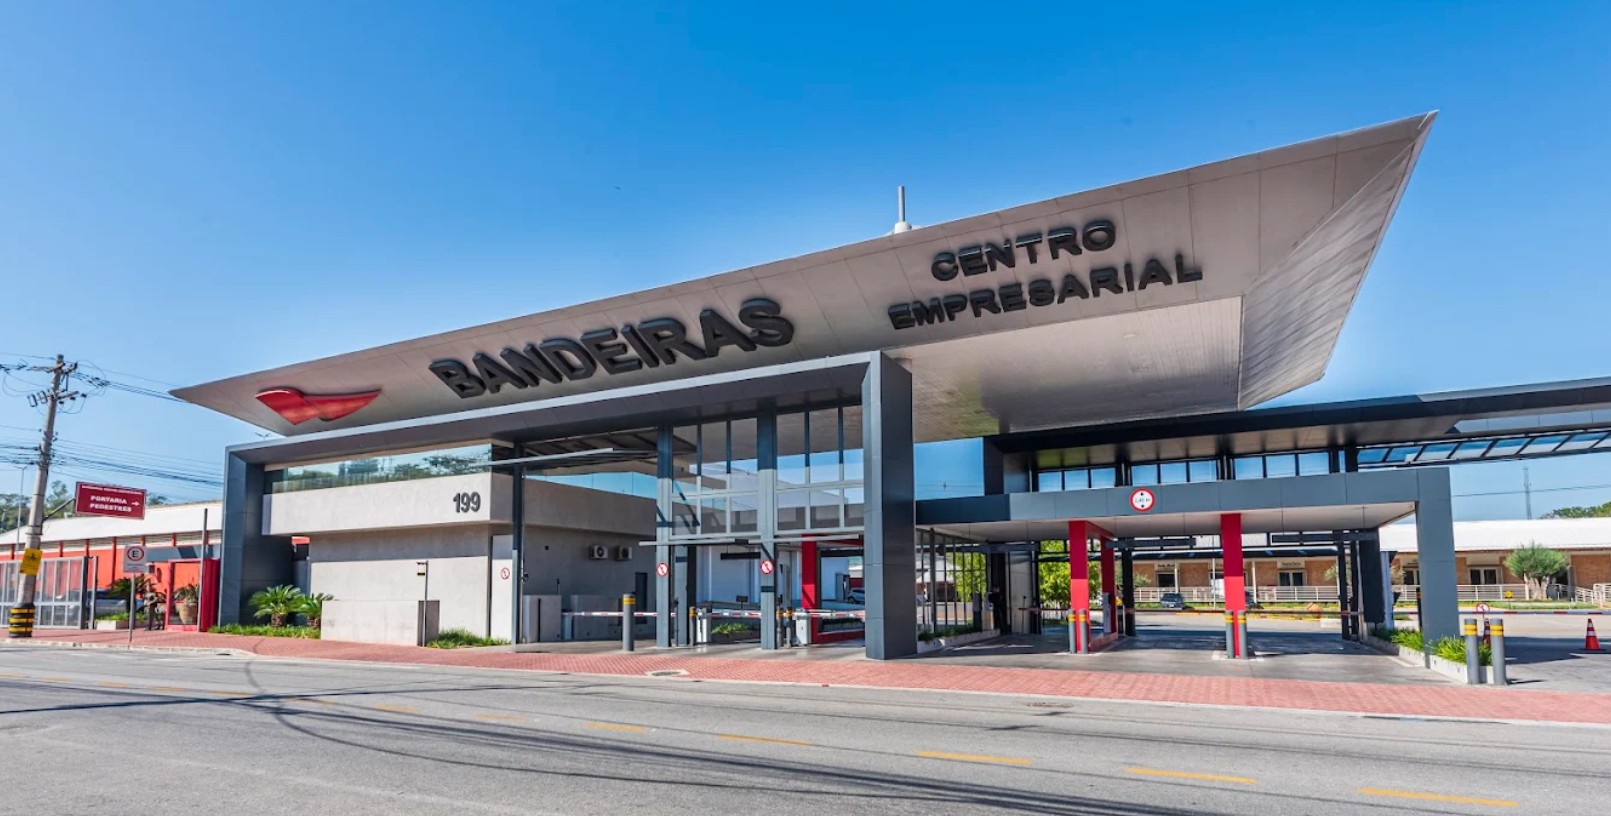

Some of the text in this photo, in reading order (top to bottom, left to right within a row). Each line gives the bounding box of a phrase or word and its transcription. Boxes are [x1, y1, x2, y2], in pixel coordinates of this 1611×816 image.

[931, 219, 1117, 282] CENTRO
[888, 253, 1203, 330] EMPRESARIAL
[429, 297, 795, 400] BANDEIRAS
[90, 503, 132, 512] PEDESTRES
[91, 495, 127, 504] PORTARIA
[453, 491, 481, 513] 199
